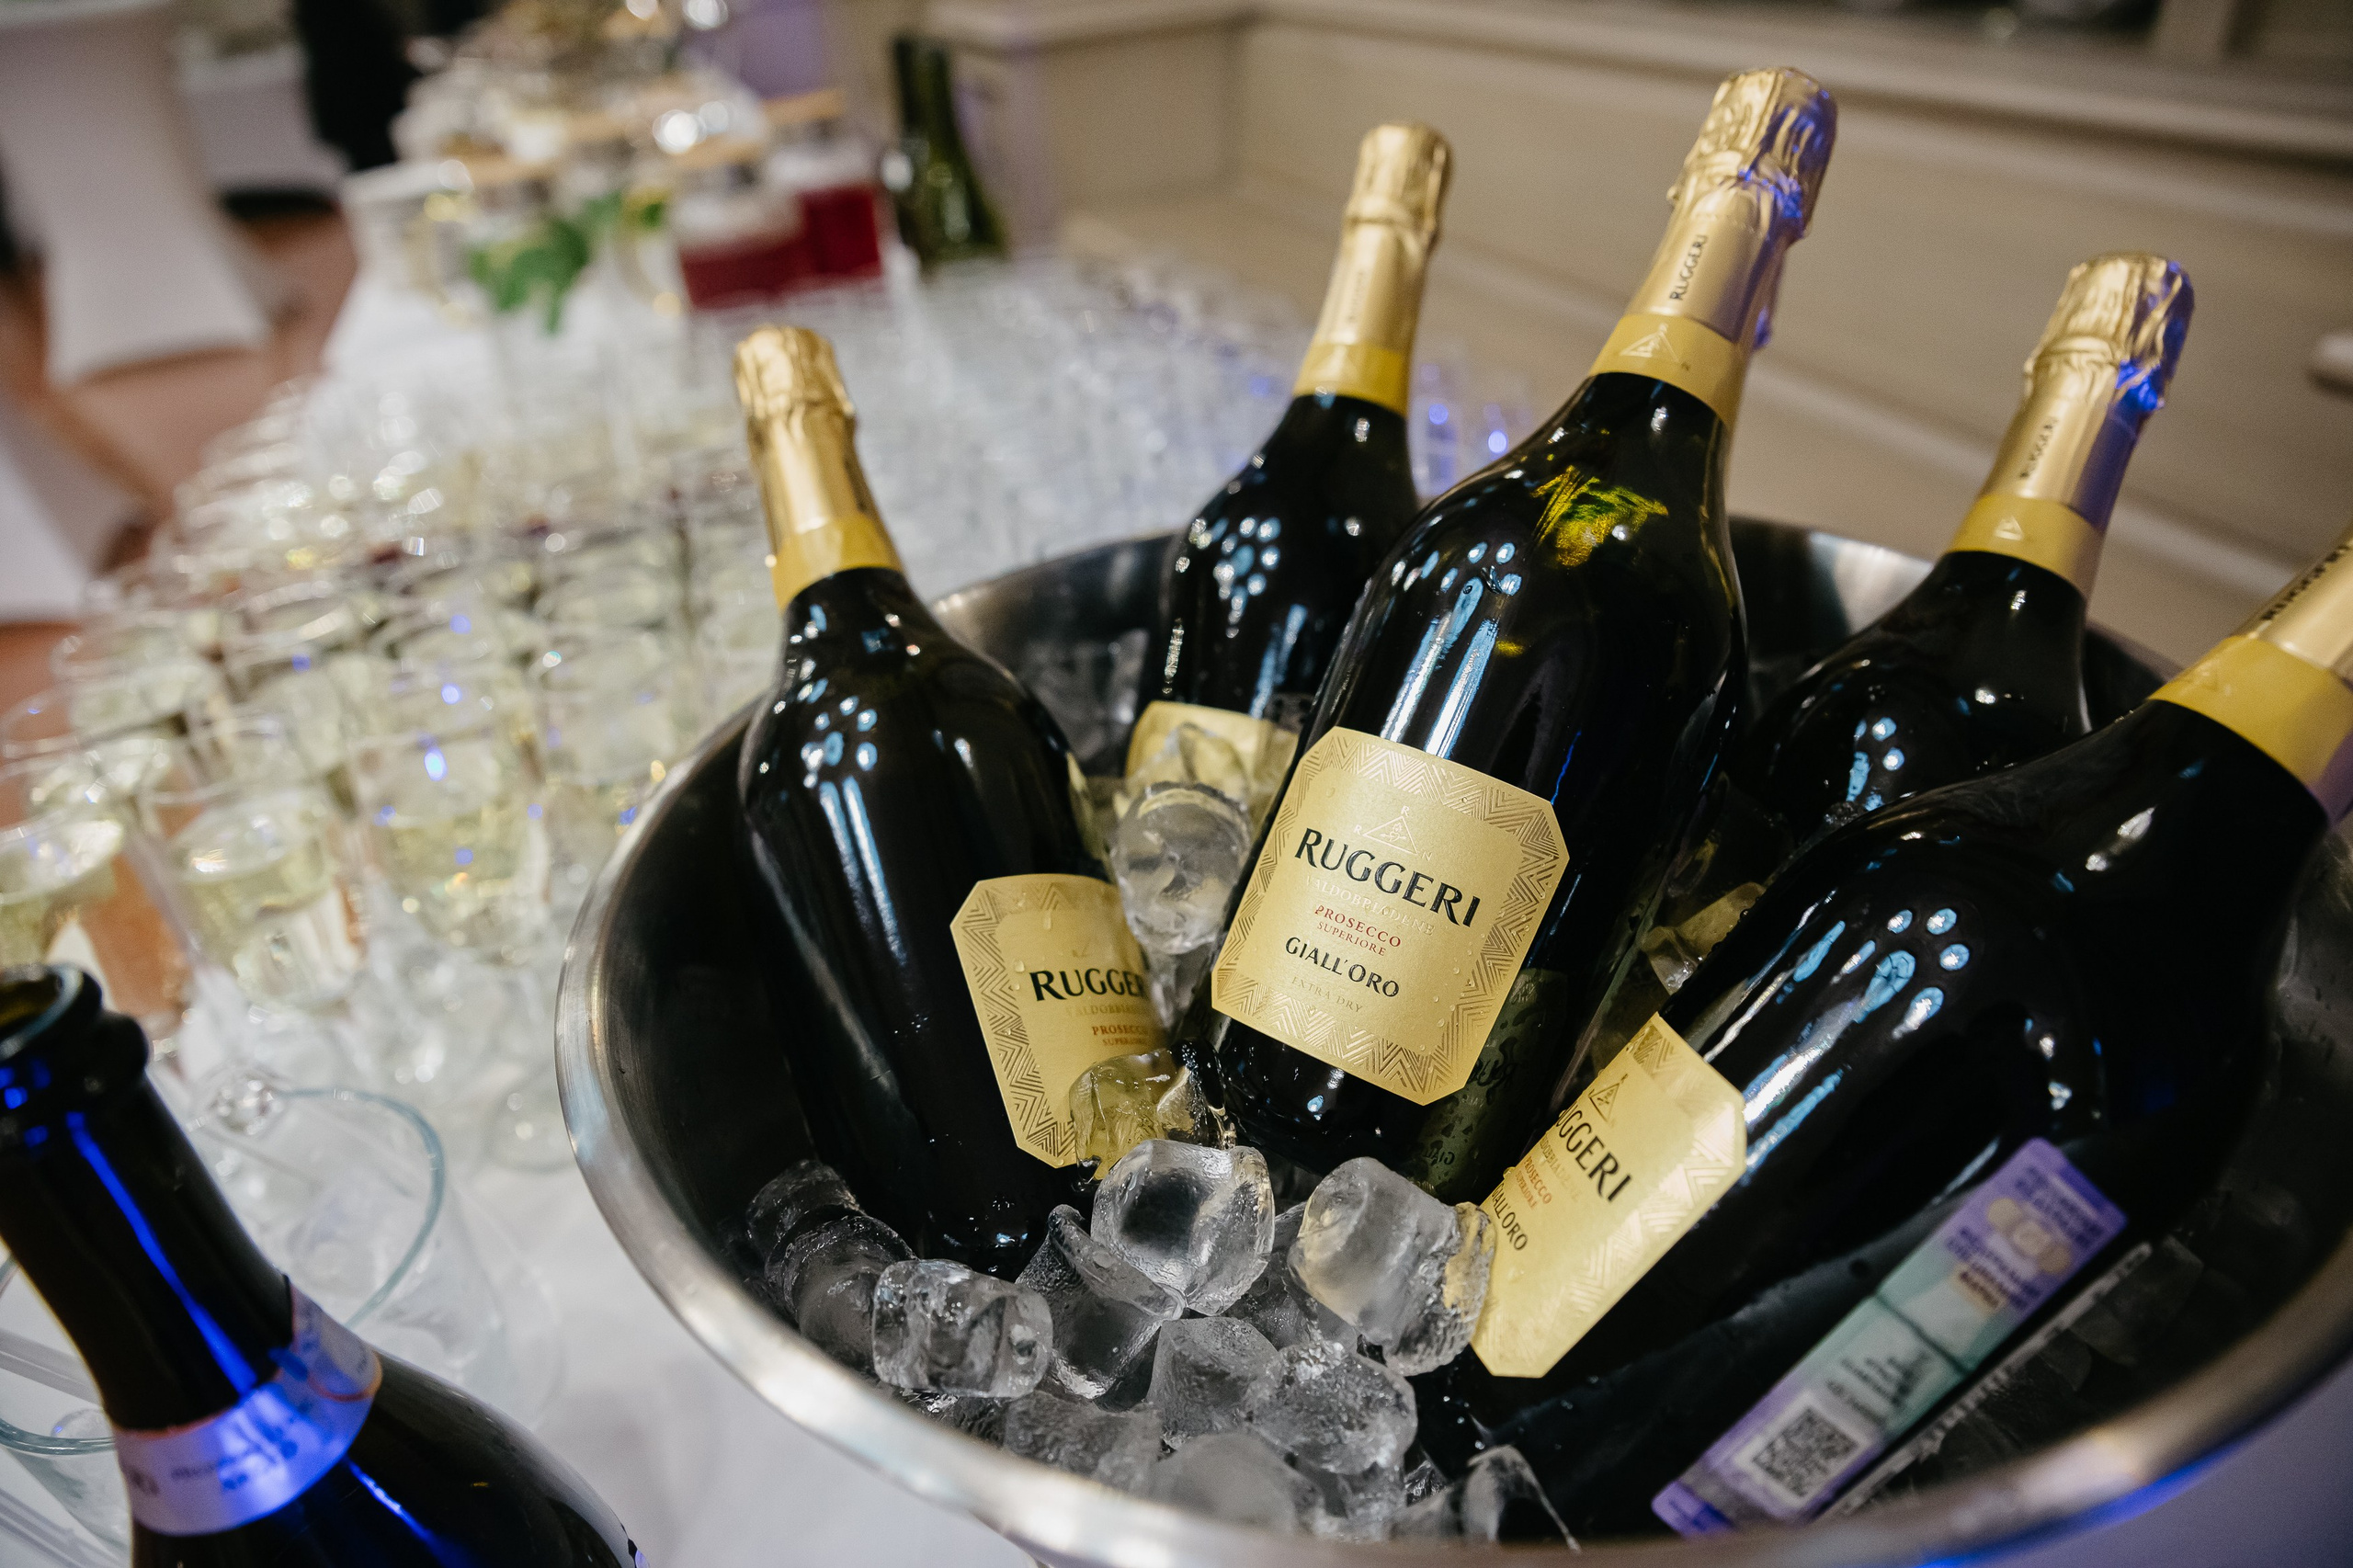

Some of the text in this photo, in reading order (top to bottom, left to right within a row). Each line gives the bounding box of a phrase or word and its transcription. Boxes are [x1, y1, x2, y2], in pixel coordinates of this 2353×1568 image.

[1669, 234, 1708, 301] RUGGERI
[1353, 824, 1362, 835] R
[1401, 805, 1410, 817] R
[1294, 827, 1481, 928] RUGGERI
[1314, 904, 1402, 948] PROSECCO
[1317, 921, 1387, 957] SUPERIORE
[1029, 968, 1147, 1002] RUGGER
[1285, 937, 1400, 997] GIALL'ORO
[1291, 976, 1363, 1013] EXTRA DRY
[1555, 1101, 1631, 1202] UGGERI
